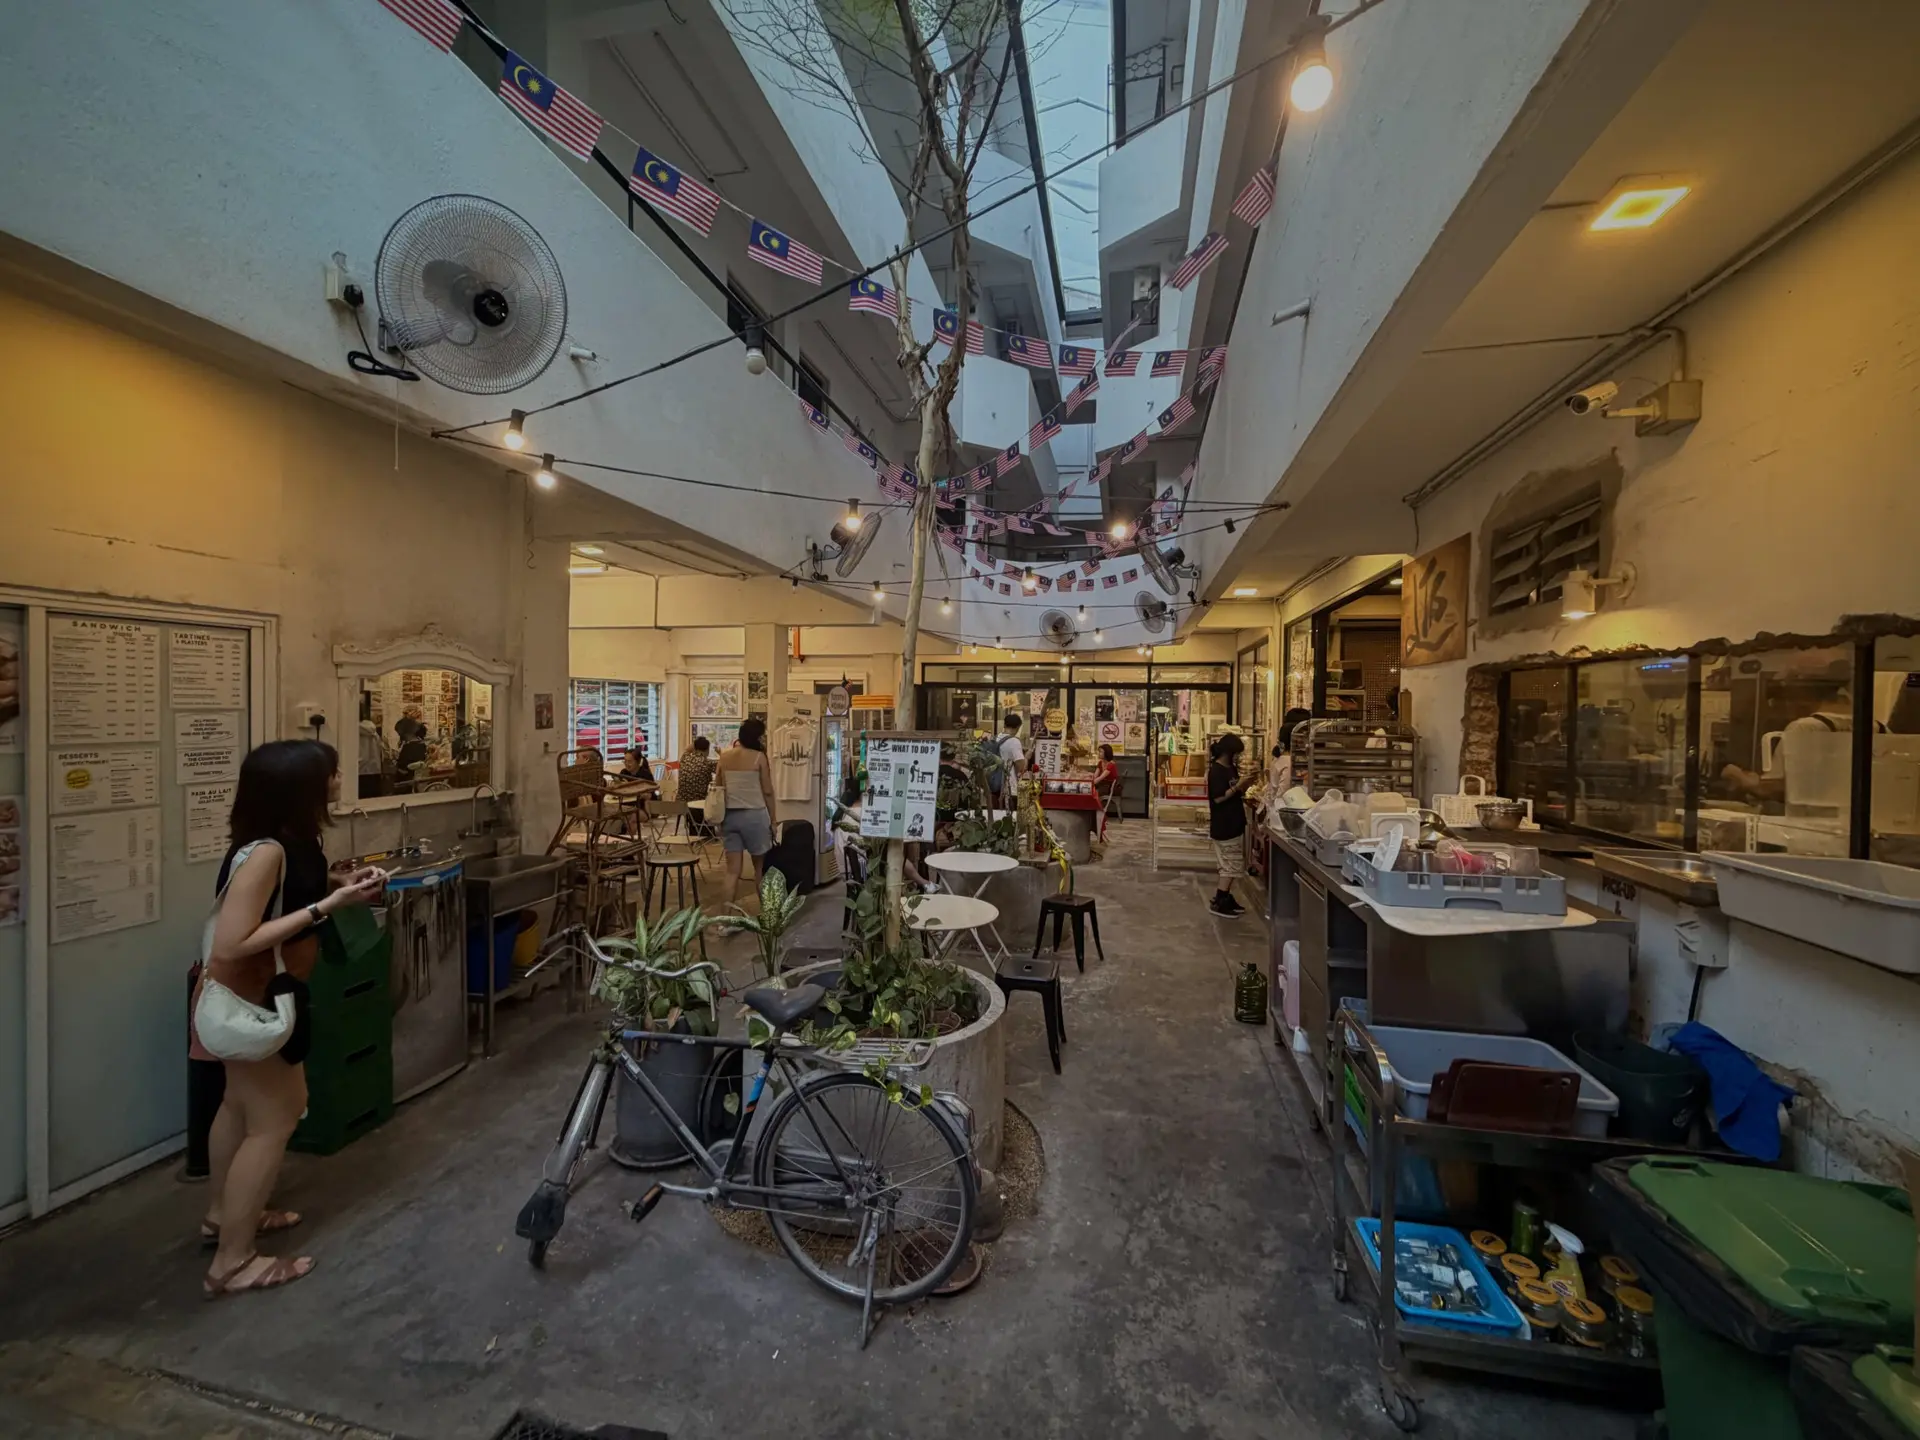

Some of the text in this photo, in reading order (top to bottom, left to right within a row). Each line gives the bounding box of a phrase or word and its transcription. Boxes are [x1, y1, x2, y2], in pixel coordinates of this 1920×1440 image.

[72, 621, 141, 632] SANDWICH
[174, 633, 210, 641] TARTINES
[930, 746, 935, 754] ?
[58, 752, 99, 760] DESSERTS
[1048, 744, 1059, 773] tomm
[1602, 875, 1636, 901] PICK-UP
